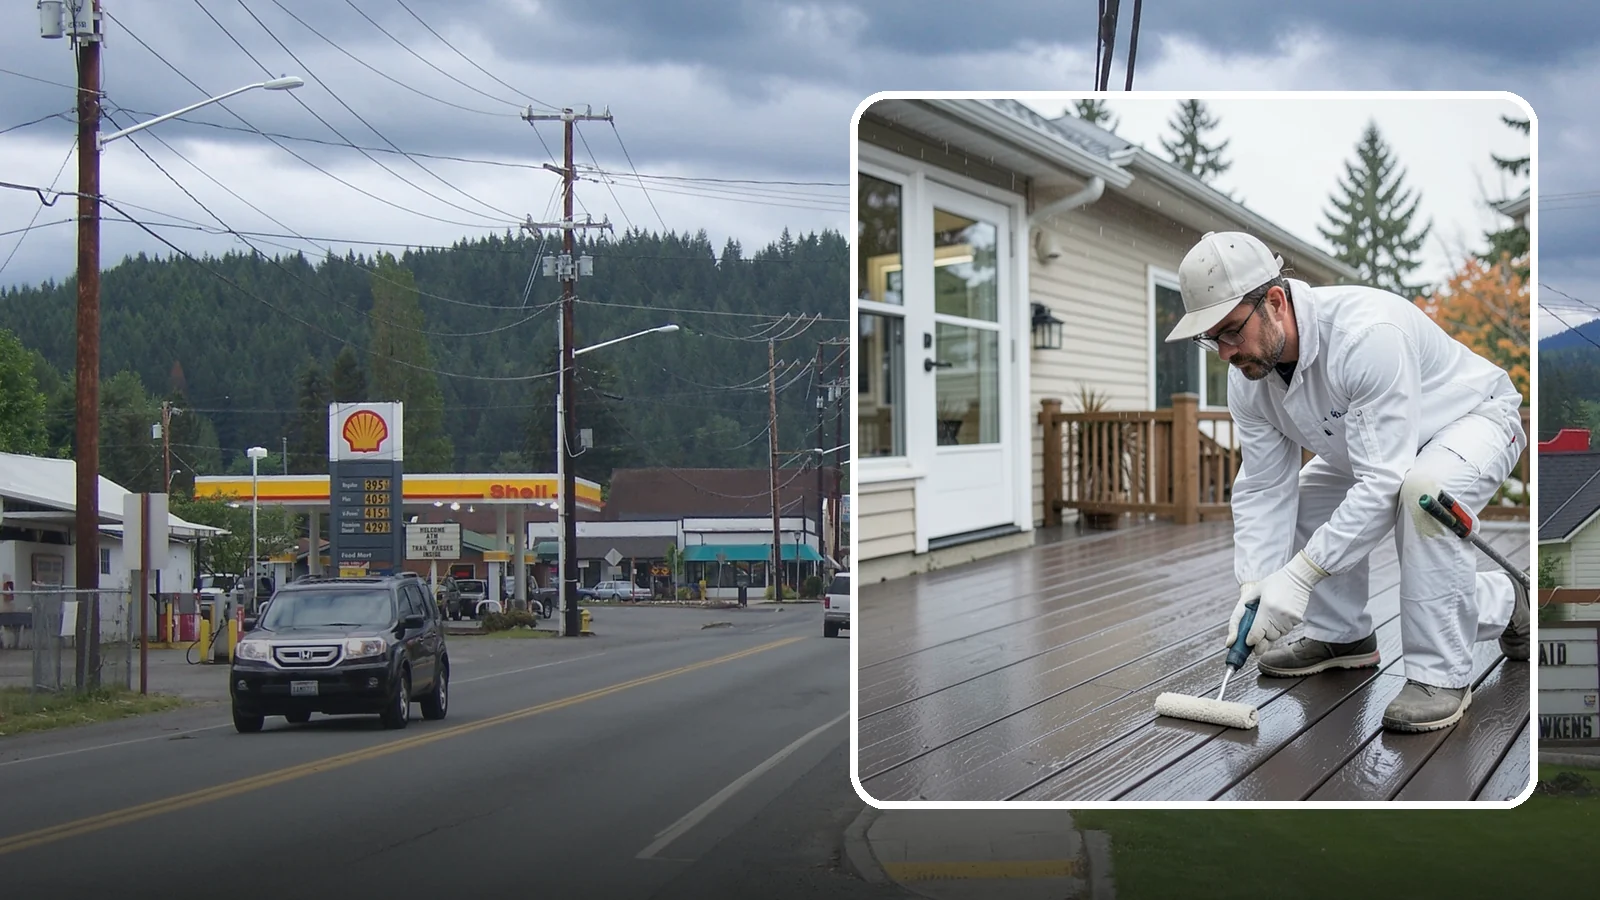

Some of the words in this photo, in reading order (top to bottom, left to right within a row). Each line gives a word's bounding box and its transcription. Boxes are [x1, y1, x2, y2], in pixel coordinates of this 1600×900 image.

[365, 480, 384, 490] 395
[490, 484, 548, 499] Shell
[365, 494, 384, 504] 405
[365, 509, 384, 518] 415
[365, 522, 384, 533] 429
[1538, 642, 1567, 666] AID
